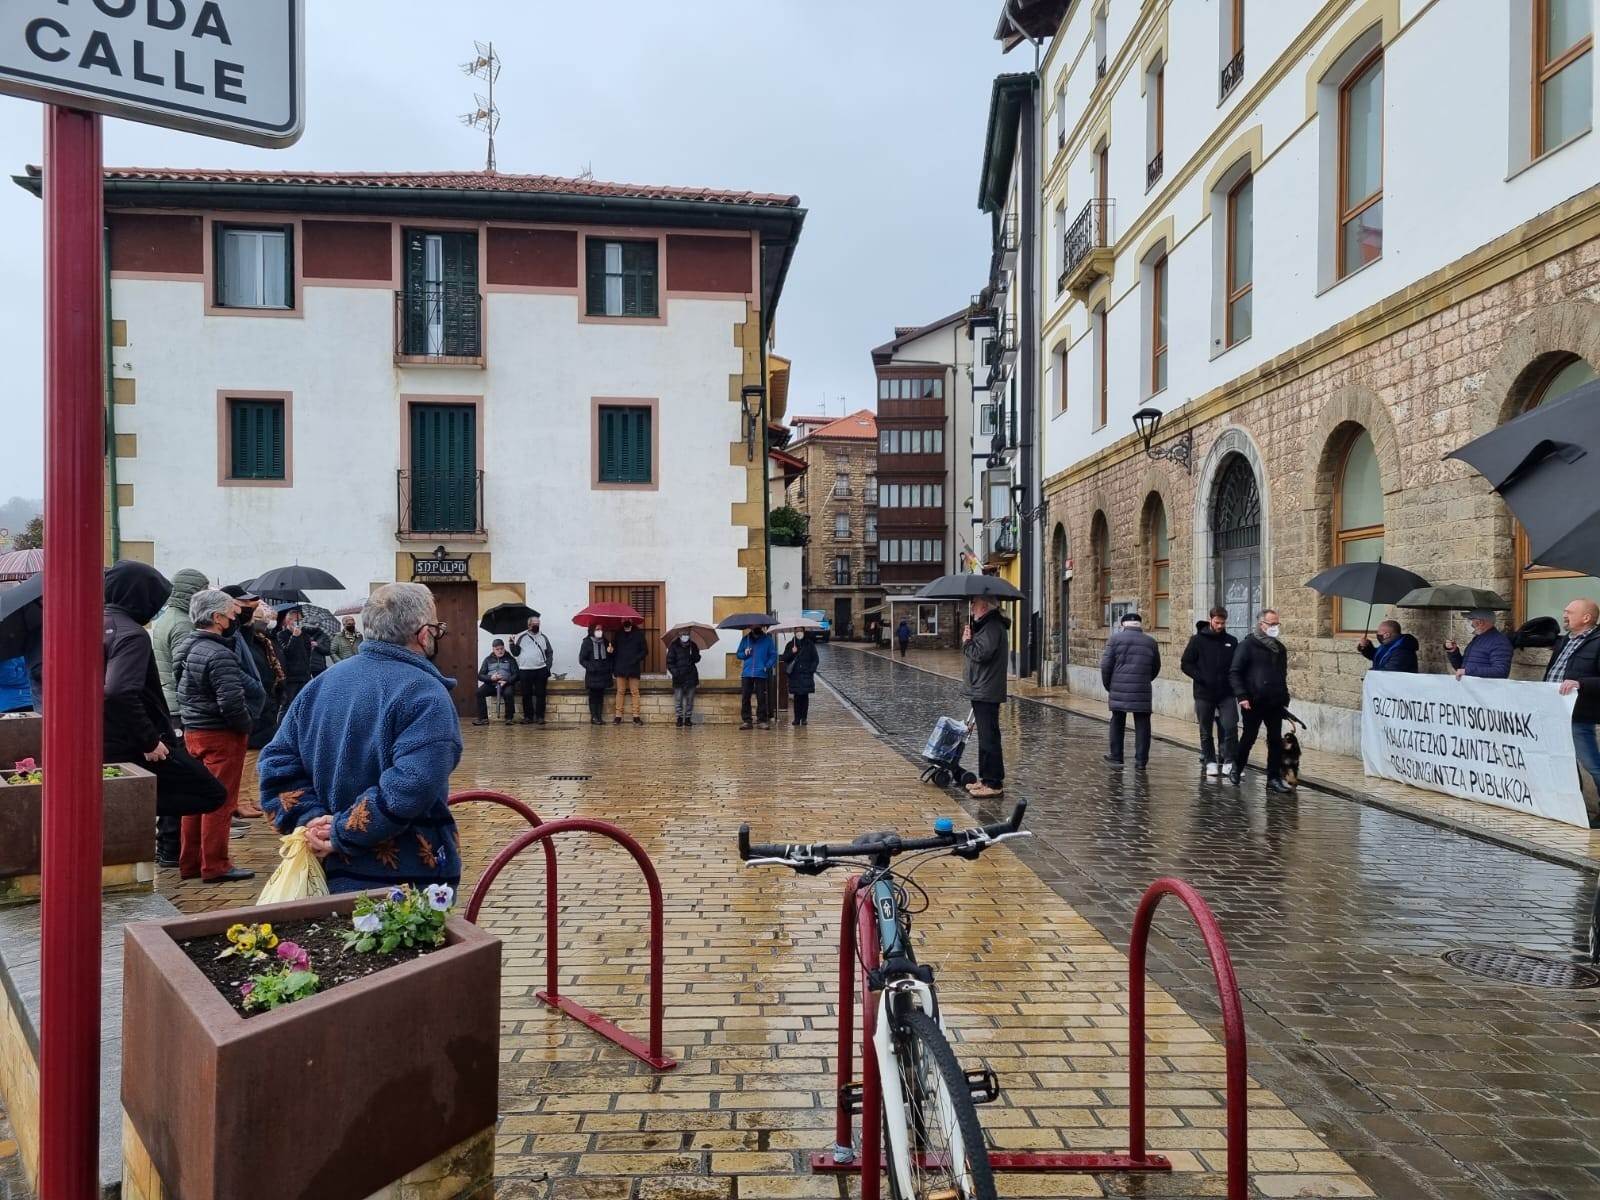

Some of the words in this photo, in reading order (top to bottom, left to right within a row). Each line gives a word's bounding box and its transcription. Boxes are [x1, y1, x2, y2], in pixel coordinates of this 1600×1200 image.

[57, 0, 233, 46] DA
[25, 17, 247, 104] CALLE
[1450, 735, 1504, 767] ZAINTZA
[1502, 744, 1527, 770] ETA
[1469, 770, 1533, 807] PUBLIKOA
